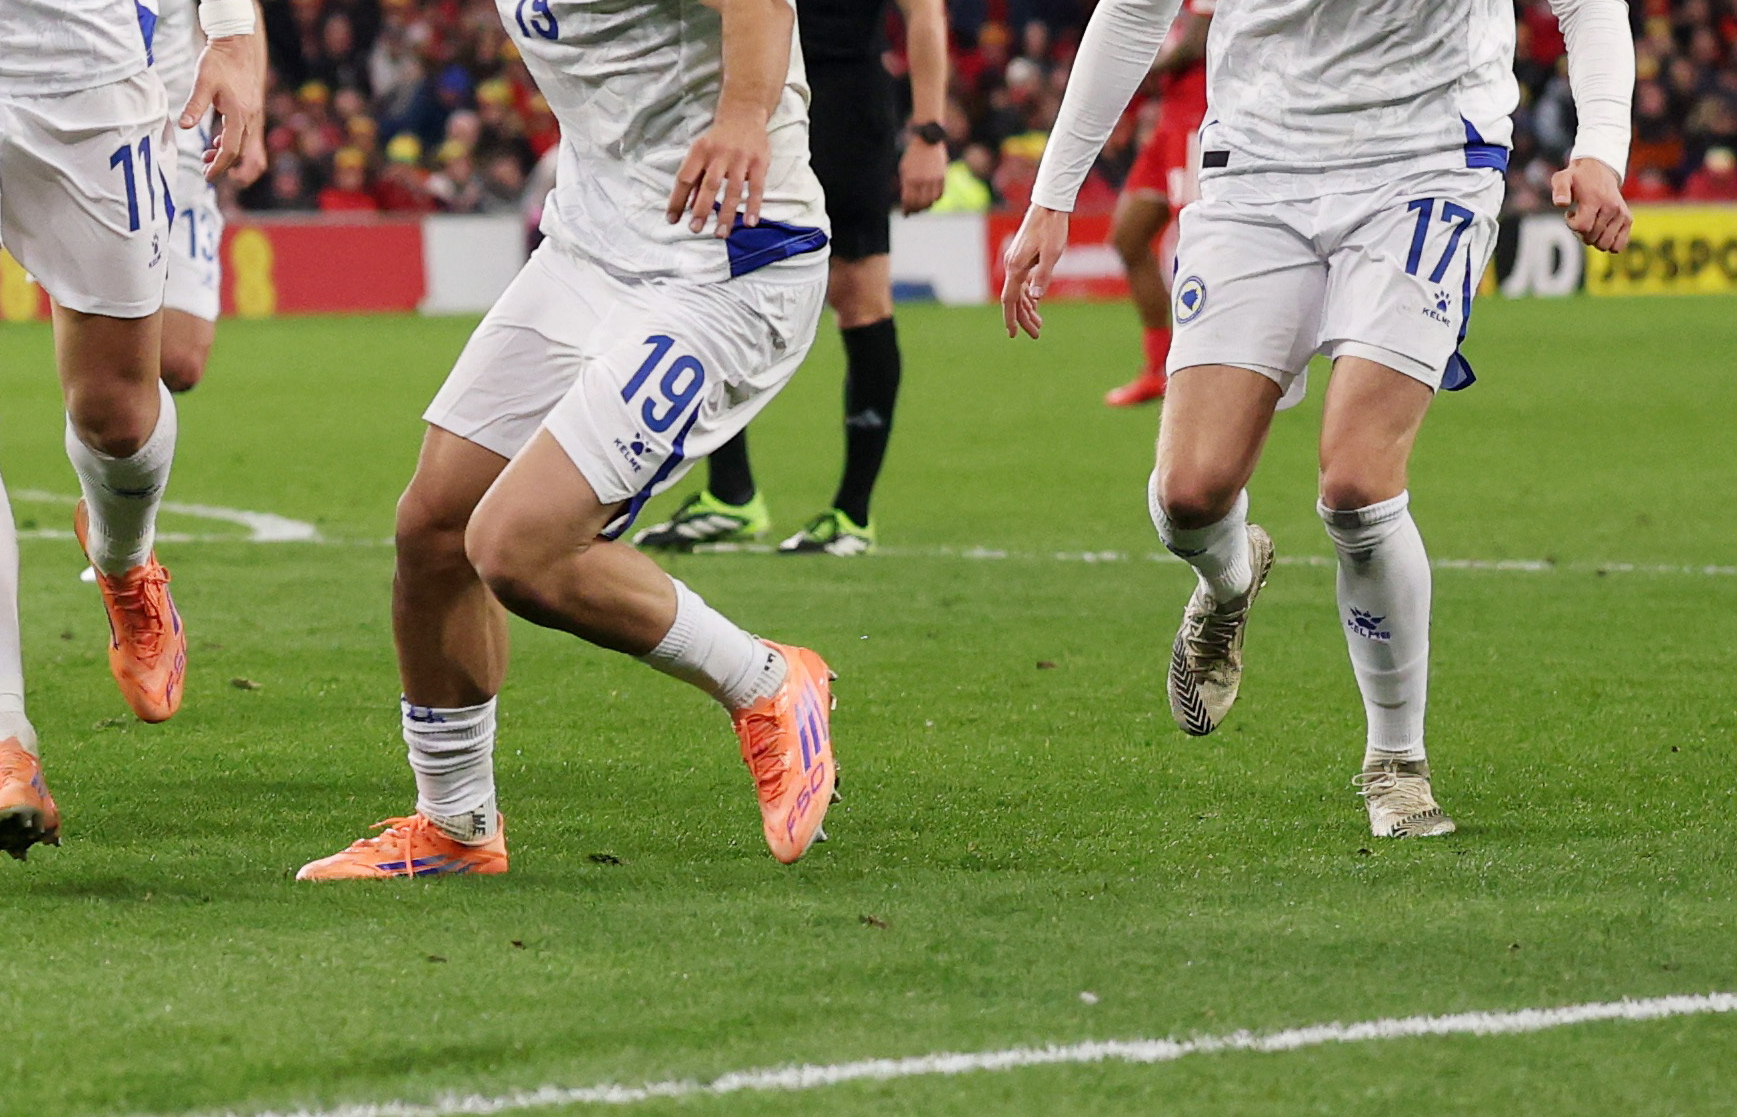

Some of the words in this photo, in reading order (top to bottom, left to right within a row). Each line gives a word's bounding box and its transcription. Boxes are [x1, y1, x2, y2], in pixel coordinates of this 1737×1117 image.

[110, 135, 155, 232] 11
[1405, 198, 1474, 284] 17
[1500, 212, 1584, 300] JD
[621, 334, 705, 433] 19
[614, 437, 642, 473] KELME
[787, 761, 825, 844] F50
